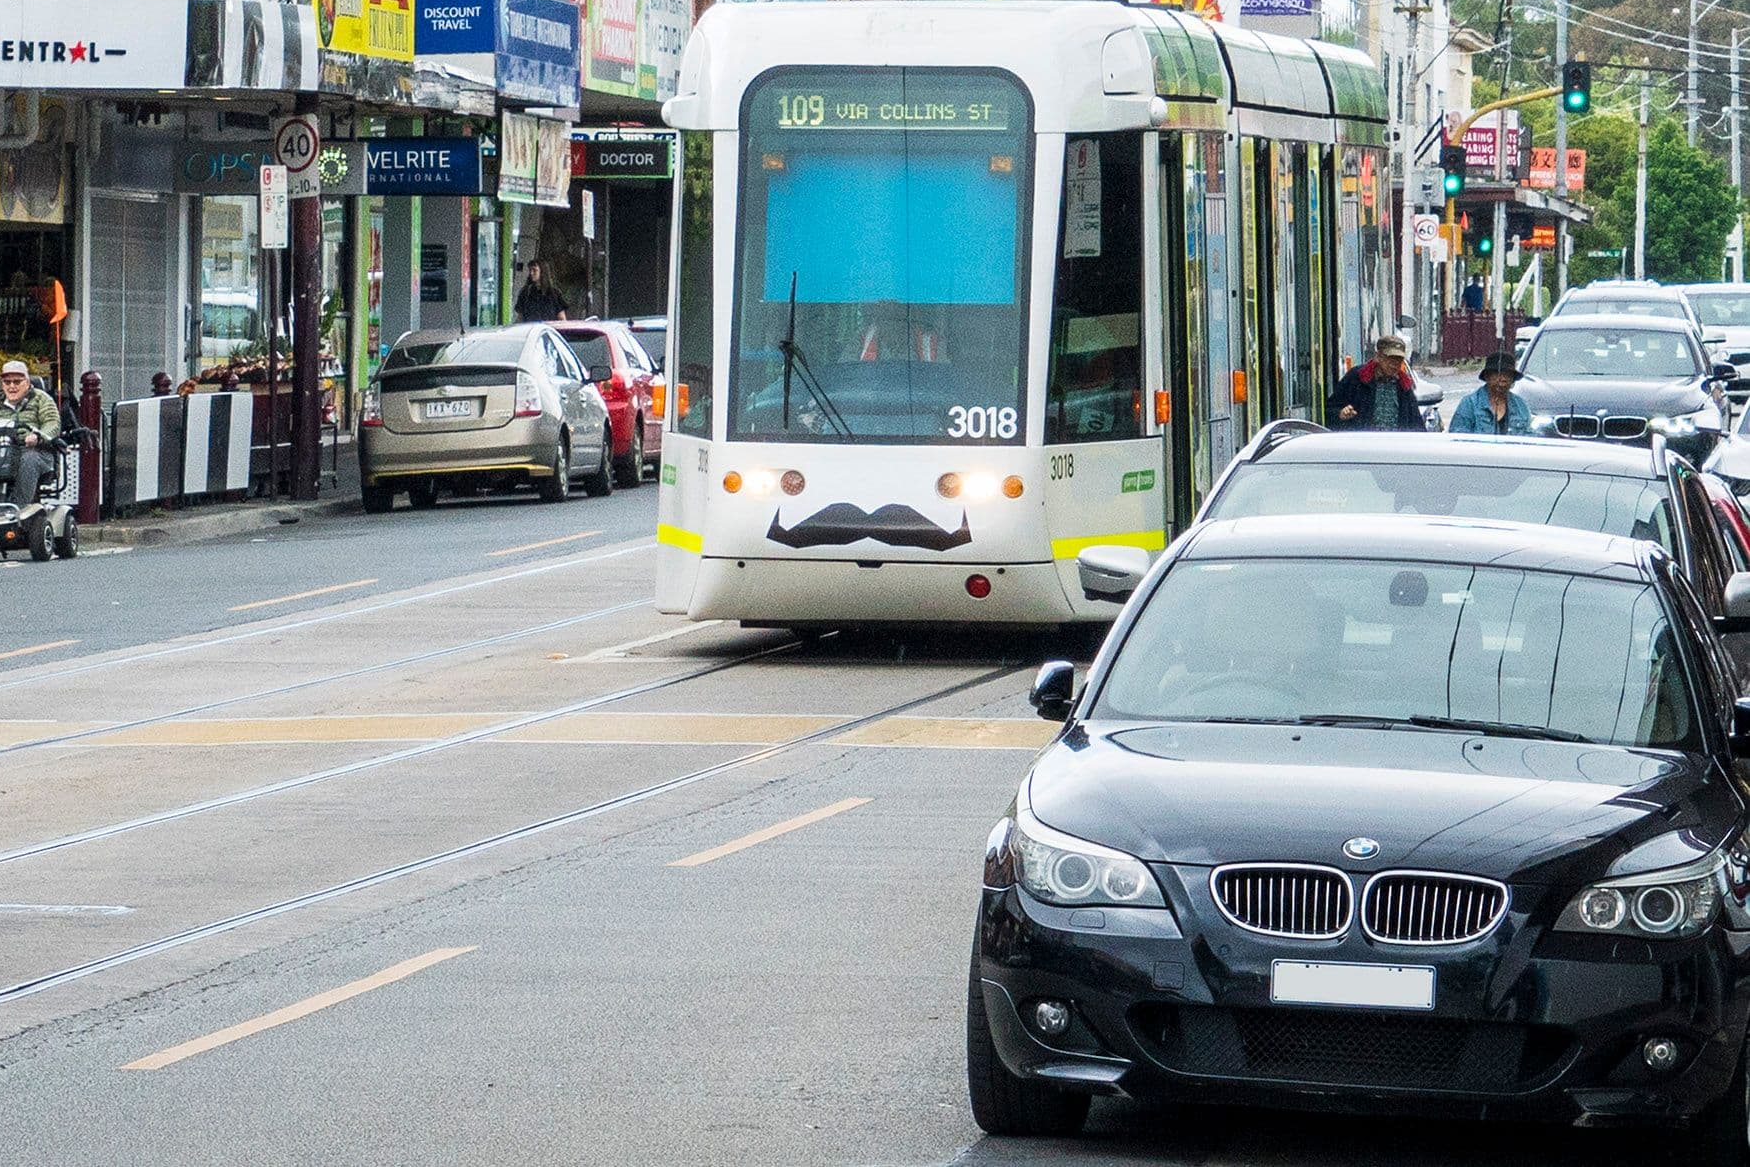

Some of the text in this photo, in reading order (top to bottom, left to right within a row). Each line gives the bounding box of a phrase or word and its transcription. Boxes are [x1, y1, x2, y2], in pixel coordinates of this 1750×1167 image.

[424, 6, 482, 19] DISCOUNT
[431, 18, 472, 30] TRAVEL
[778, 95, 993, 126] 109 VIA COLLINS ST
[282, 134, 310, 158] 40
[367, 148, 451, 169] VELRITE
[600, 153, 654, 166] DOCTOR
[369, 173, 451, 183] RNATIONAL
[947, 405, 1018, 439] 3018
[1050, 453, 1075, 481] 3018
